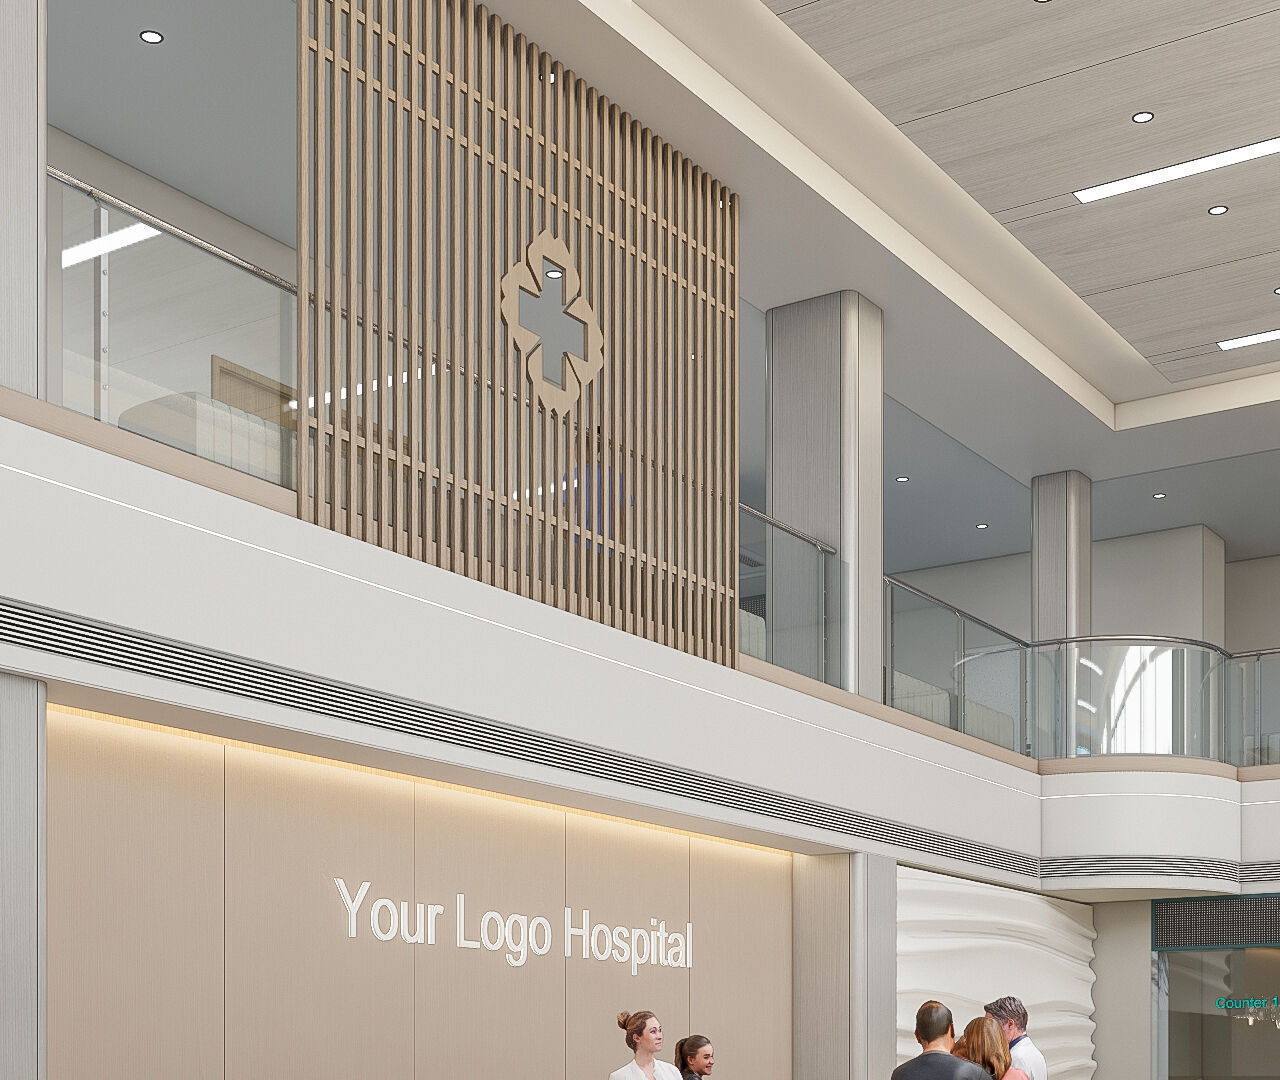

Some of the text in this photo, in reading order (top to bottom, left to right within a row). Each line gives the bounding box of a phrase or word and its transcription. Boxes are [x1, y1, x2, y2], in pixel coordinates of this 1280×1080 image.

[333, 877, 694, 976] Your Logo Hospital
[1215, 995, 1279, 1009] Counter 1
